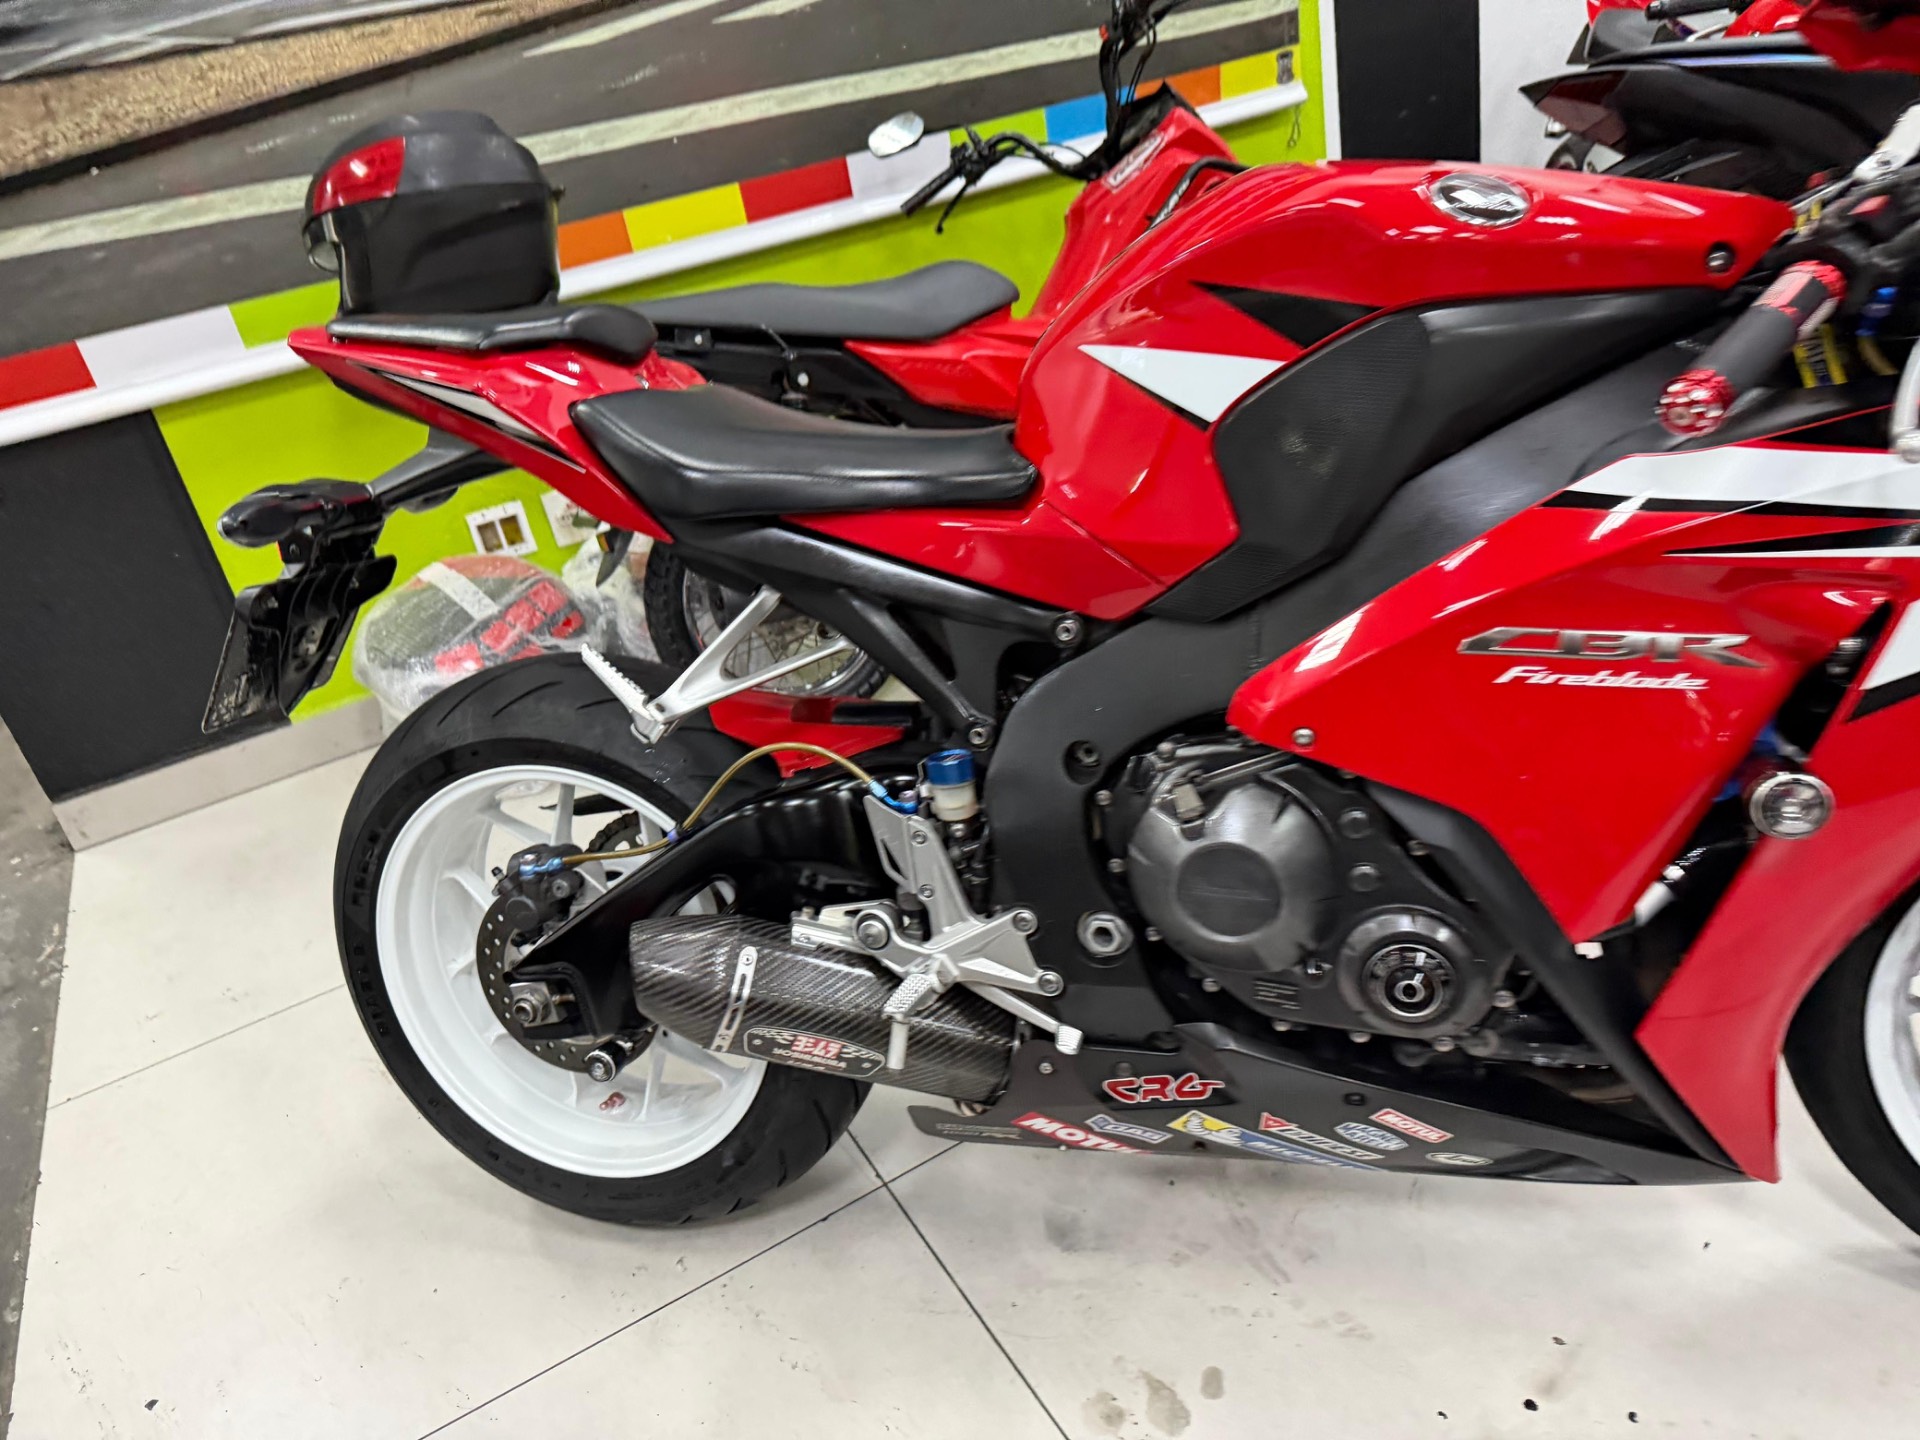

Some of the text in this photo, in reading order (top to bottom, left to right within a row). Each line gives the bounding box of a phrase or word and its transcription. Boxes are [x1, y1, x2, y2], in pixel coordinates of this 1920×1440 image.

[1457, 626, 1768, 668] CBR
[1492, 666, 1710, 690] Fireblade
[1102, 1072, 1226, 1104] CRG
[1377, 1112, 1444, 1141] MOTUL
